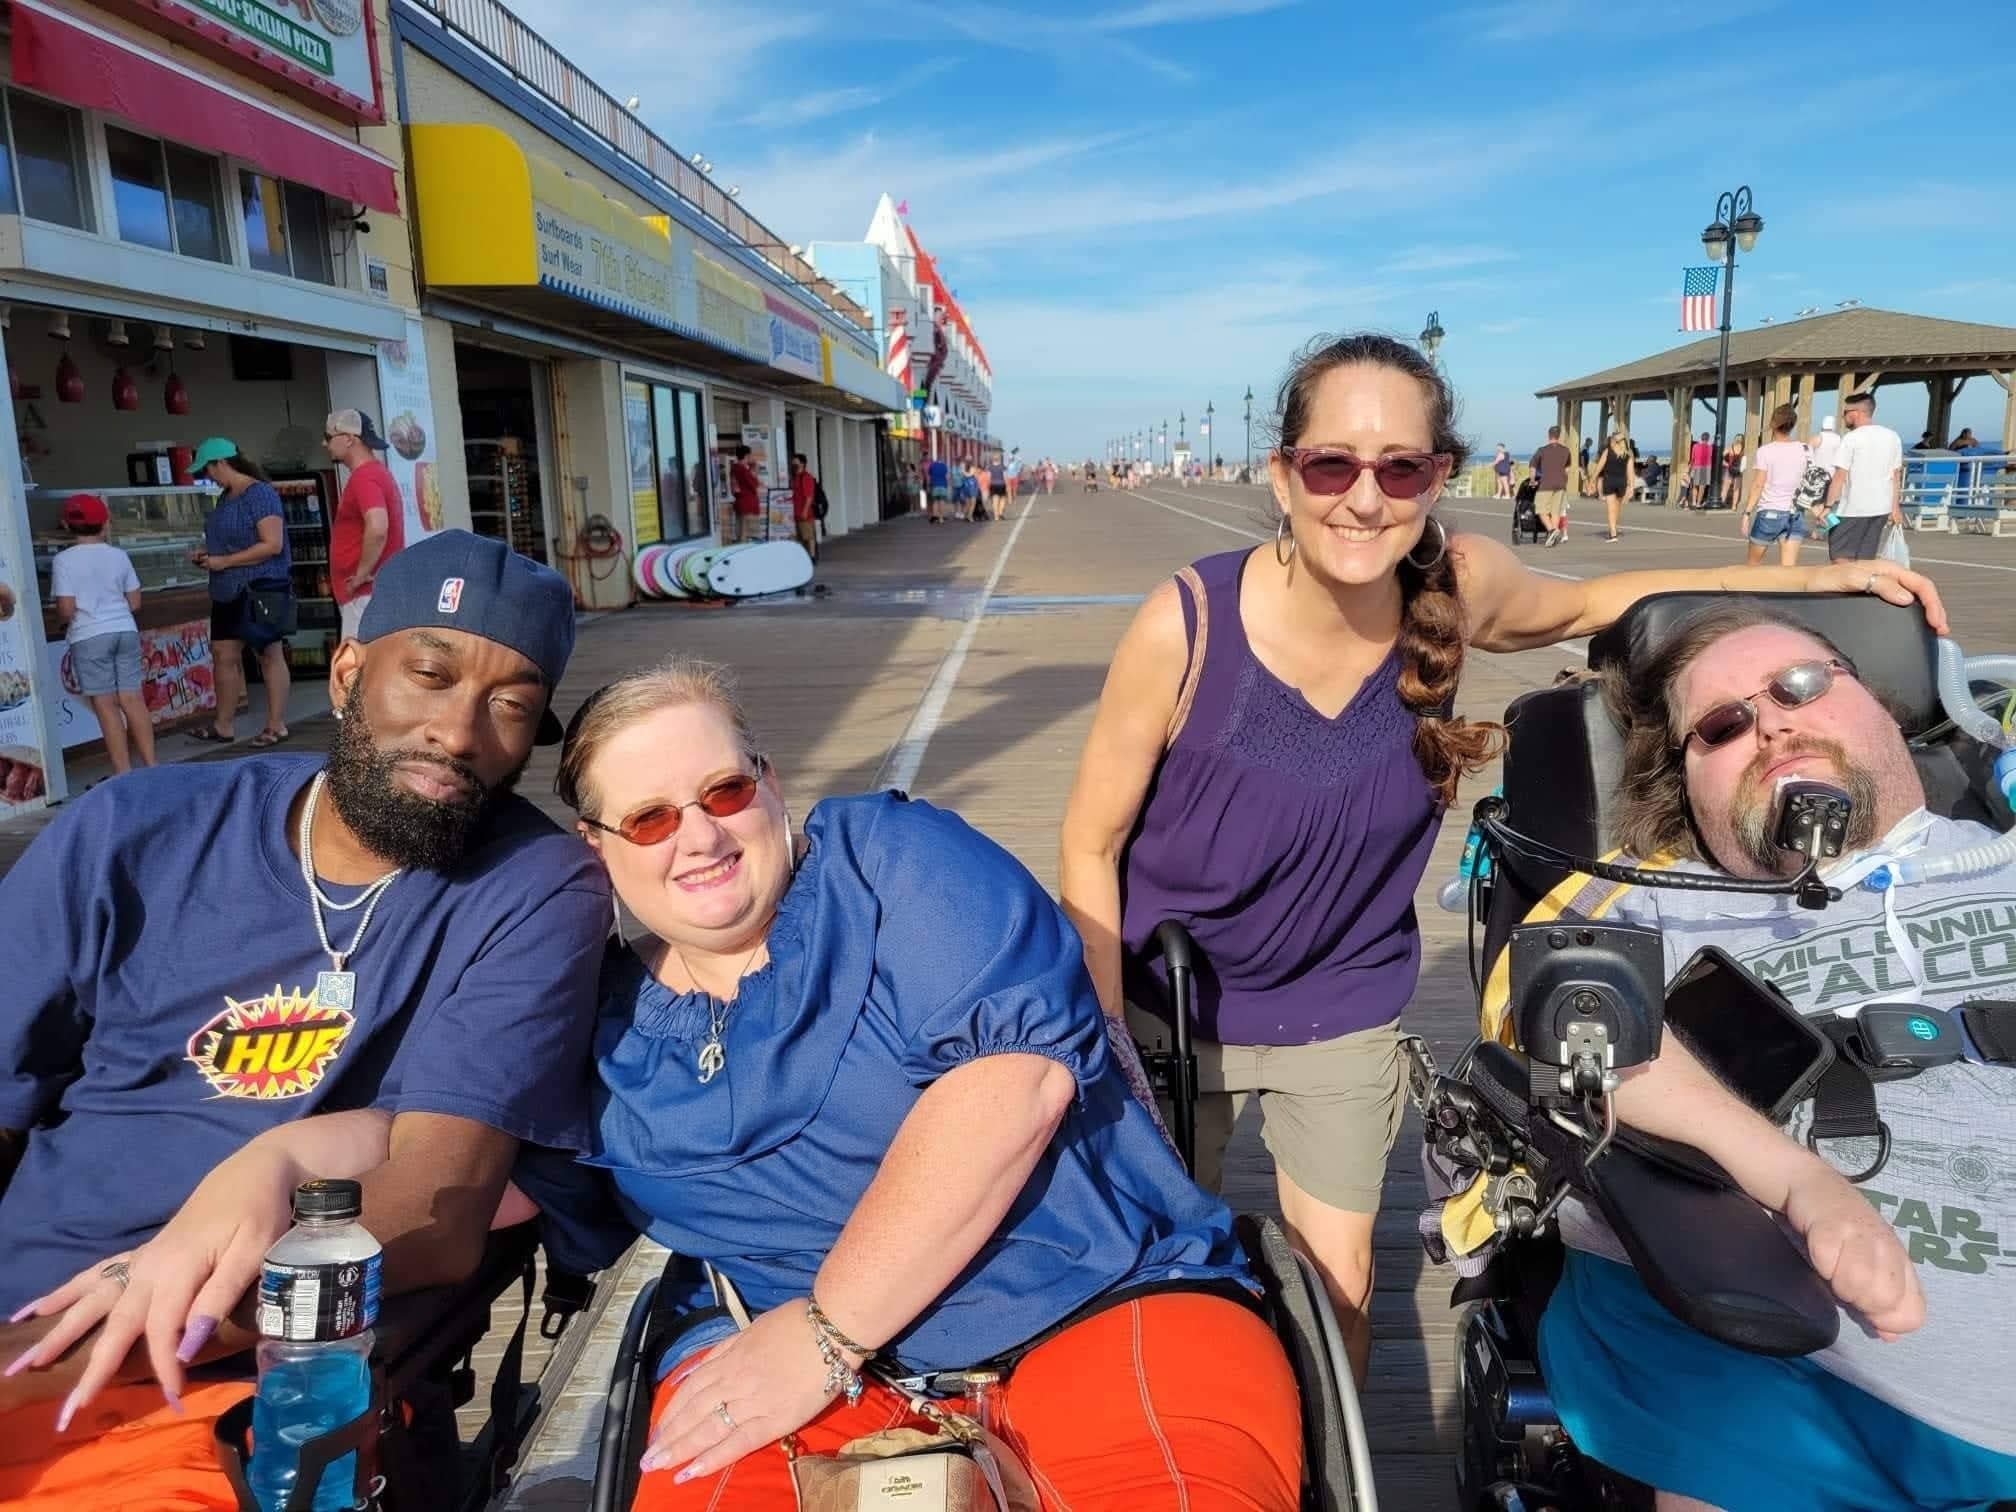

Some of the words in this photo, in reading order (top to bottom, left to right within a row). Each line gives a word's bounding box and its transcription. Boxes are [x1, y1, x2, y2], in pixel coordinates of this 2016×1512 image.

[243, 2, 293, 48] SICILIAN
[293, 29, 328, 67] PIZZA
[536, 211, 583, 250] Surfboards
[541, 243, 560, 265] Surf
[561, 252, 583, 277] Wear
[1754, 905, 2016, 982] MILLENNIU
[224, 1027, 346, 1074] HUF
[1909, 1231, 2000, 1274] RS
